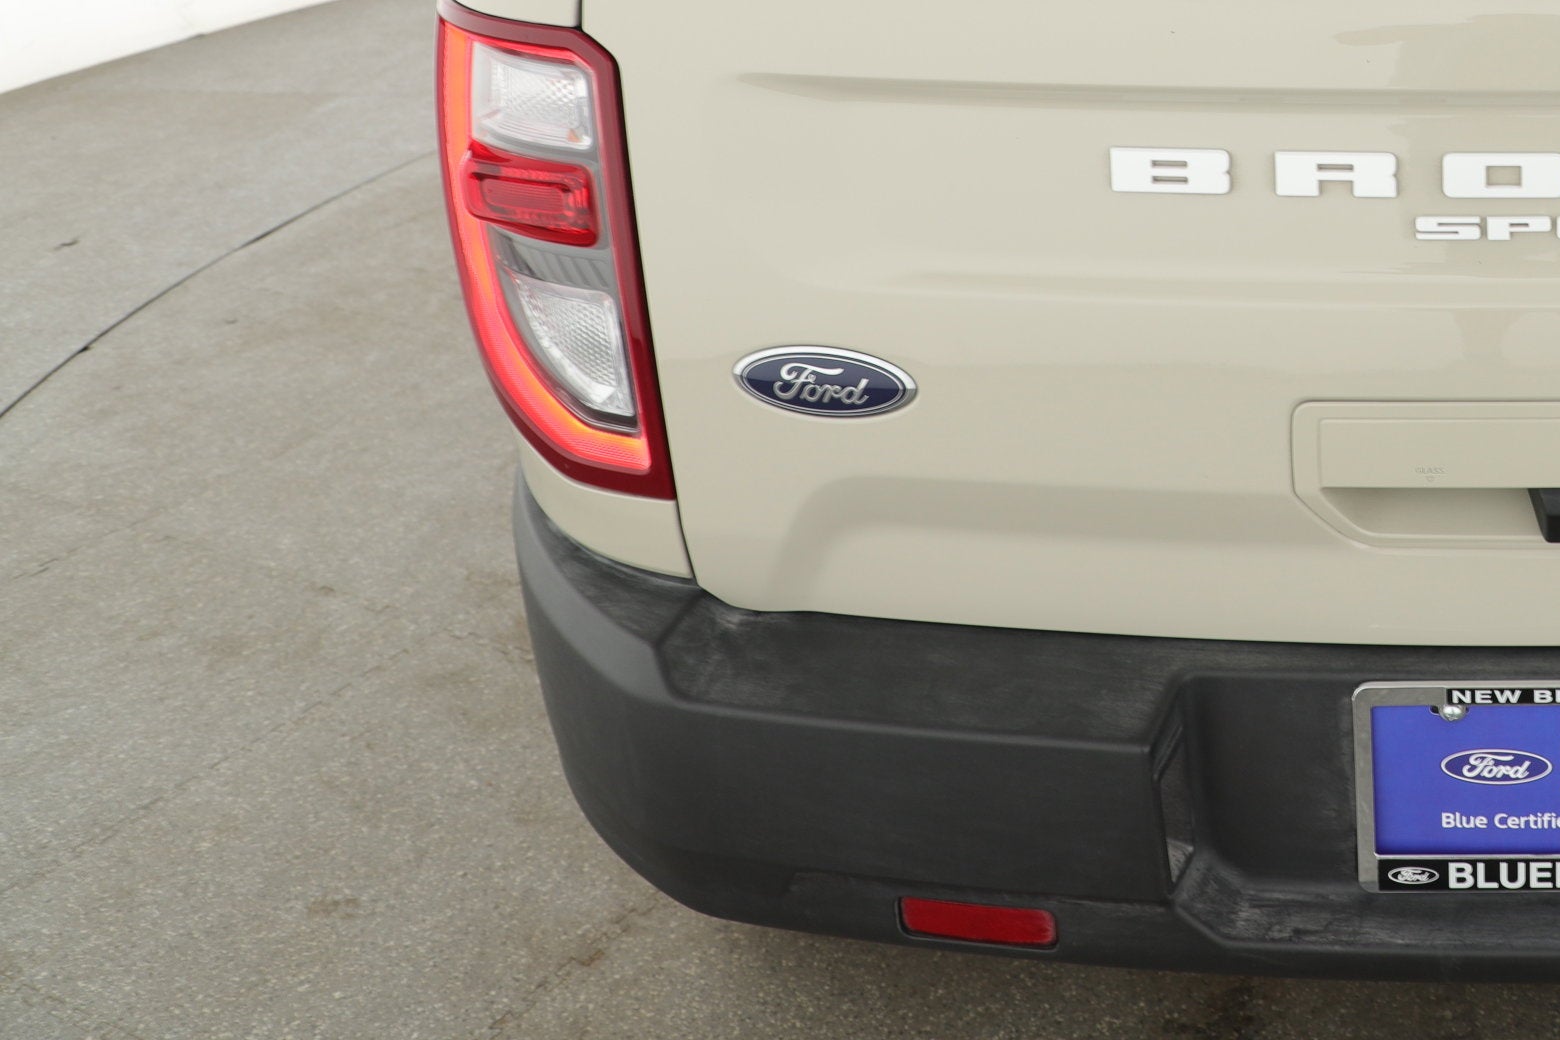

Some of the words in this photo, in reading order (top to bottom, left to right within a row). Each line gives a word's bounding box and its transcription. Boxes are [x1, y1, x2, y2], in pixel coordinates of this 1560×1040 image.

[772, 362, 870, 405] Ford
[1451, 689, 1522, 705] NEW
[1462, 753, 1532, 779] Ford
[1441, 812, 1488, 828] Blue
[1397, 868, 1431, 883] Ford
